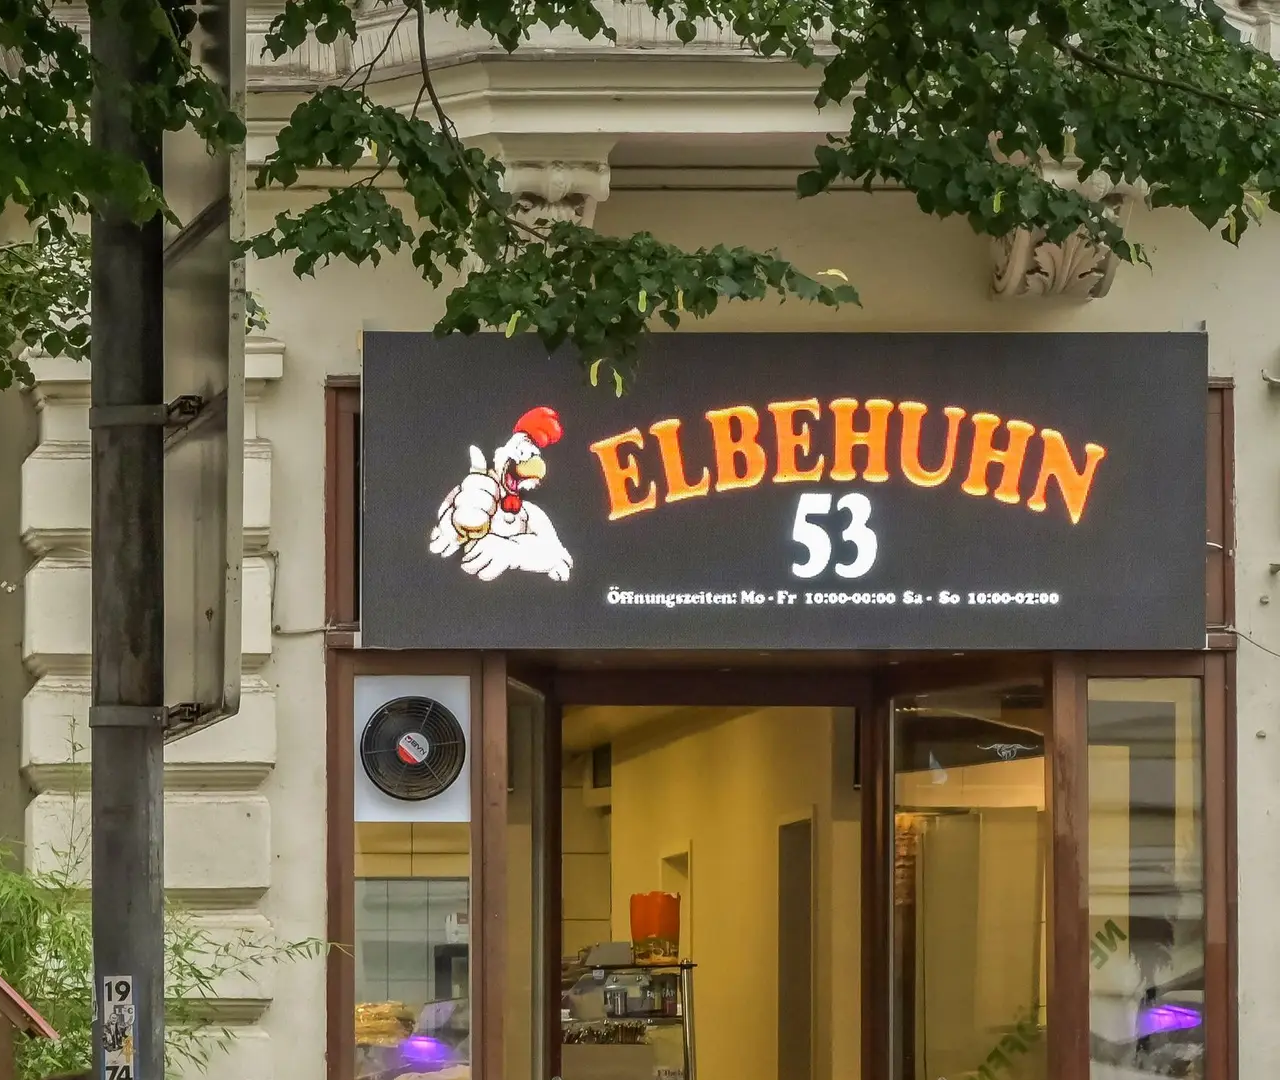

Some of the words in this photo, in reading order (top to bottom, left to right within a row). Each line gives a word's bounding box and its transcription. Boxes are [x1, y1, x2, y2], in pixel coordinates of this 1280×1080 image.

[588, 397, 1106, 524] ELBEHUHN
[791, 492, 878, 579] 53
[607, 586, 737, 608] Öffnungszeiten:
[741, 590, 766, 605] Mo
[777, 590, 797, 605] Fr
[805, 591, 896, 605] 10:00-00:00
[902, 590, 923, 605] Sa
[938, 590, 961, 605] So
[105, 980, 131, 1002] 19
